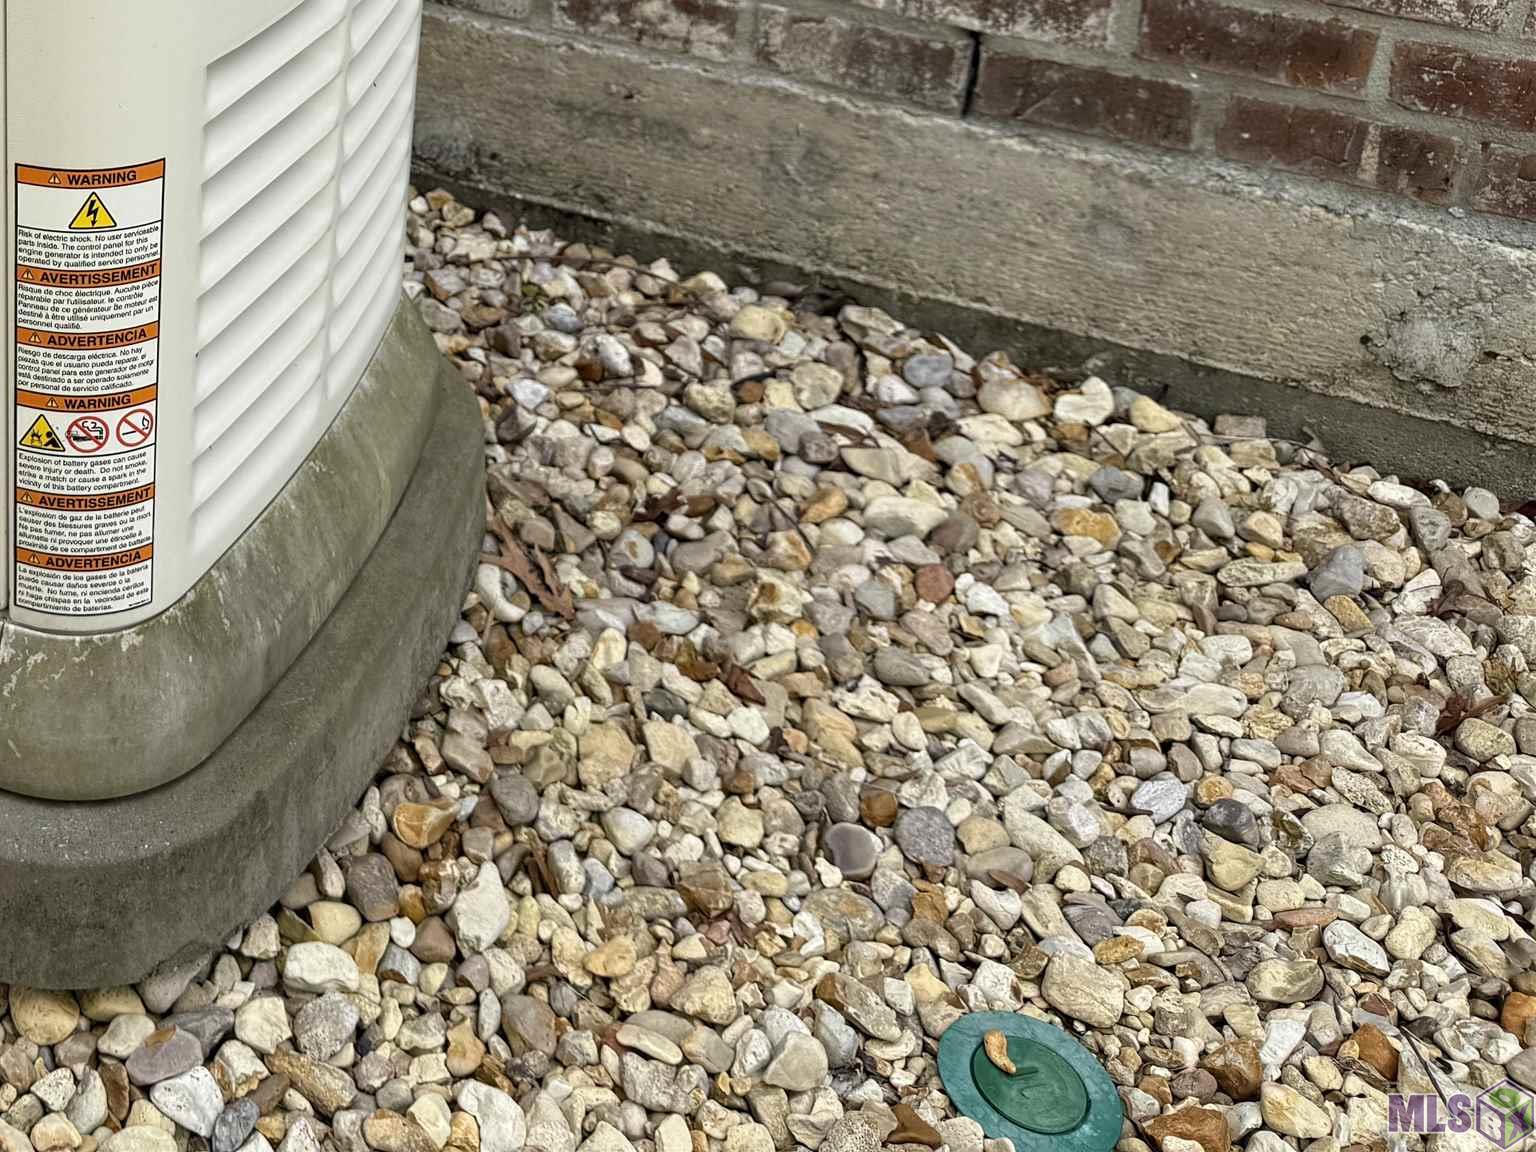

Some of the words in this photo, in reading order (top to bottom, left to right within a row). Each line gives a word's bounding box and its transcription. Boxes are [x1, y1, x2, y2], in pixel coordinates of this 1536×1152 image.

[67, 170, 137, 186] WARNING
[18, 239, 35, 247] parts
[37, 240, 59, 250] inside.
[103, 240, 123, 251] panel
[136, 236, 148, 244] this
[18, 247, 43, 256] engine
[44, 251, 81, 259] generator
[91, 248, 123, 258] intended
[134, 244, 148, 253] only
[64, 260, 96, 268] qualified
[97, 258, 123, 266] service
[40, 263, 157, 285] AVERTISSEMENT
[18, 317, 52, 328] personnel
[90, 309, 132, 322] uniquement
[47, 328, 147, 346] ADVERTENCIA
[53, 352, 86, 362] descarga
[131, 347, 142, 355] hay
[91, 359, 113, 369] pueda
[86, 375, 114, 386] operado
[72, 384, 99, 392] servicio
[64, 395, 131, 410] WARNING
[63, 459, 88, 468] battery
[90, 459, 111, 468] gases
[112, 464, 123, 472] not
[66, 484, 91, 493] battery
[38, 488, 151, 508] AVERTISSEMENT
[46, 551, 142, 569] ADVERTENCIA
